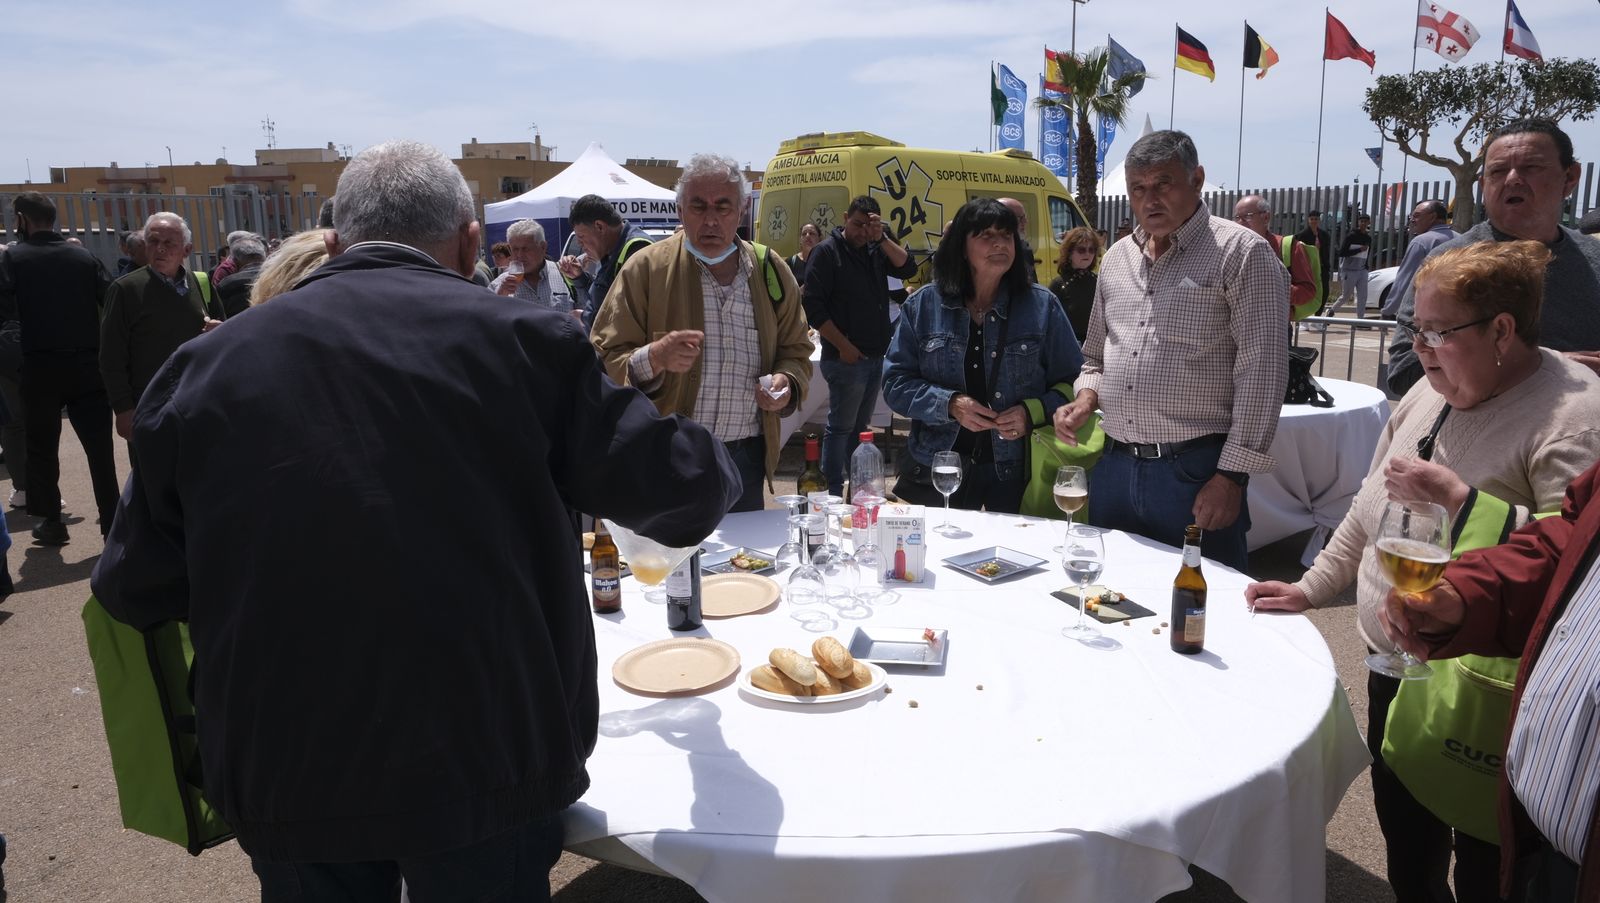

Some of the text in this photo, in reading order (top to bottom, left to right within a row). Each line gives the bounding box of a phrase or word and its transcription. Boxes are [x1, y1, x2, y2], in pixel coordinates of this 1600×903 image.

[1004, 127, 1020, 137] BCS
[773, 153, 840, 171] AMBULANCIA
[766, 170, 847, 188] SOPORTE VITAL AVANZADO
[884, 168, 907, 201] U
[936, 169, 1046, 188] SOPORTE VITAL AVANZADO
[611, 201, 676, 214] TO DE MAN
[775, 210, 781, 220] U
[820, 207, 826, 217] U
[772, 220, 782, 230] 24
[816, 217, 828, 228] 24
[890, 195, 927, 241] 24
[1444, 738, 1502, 768] CUC
